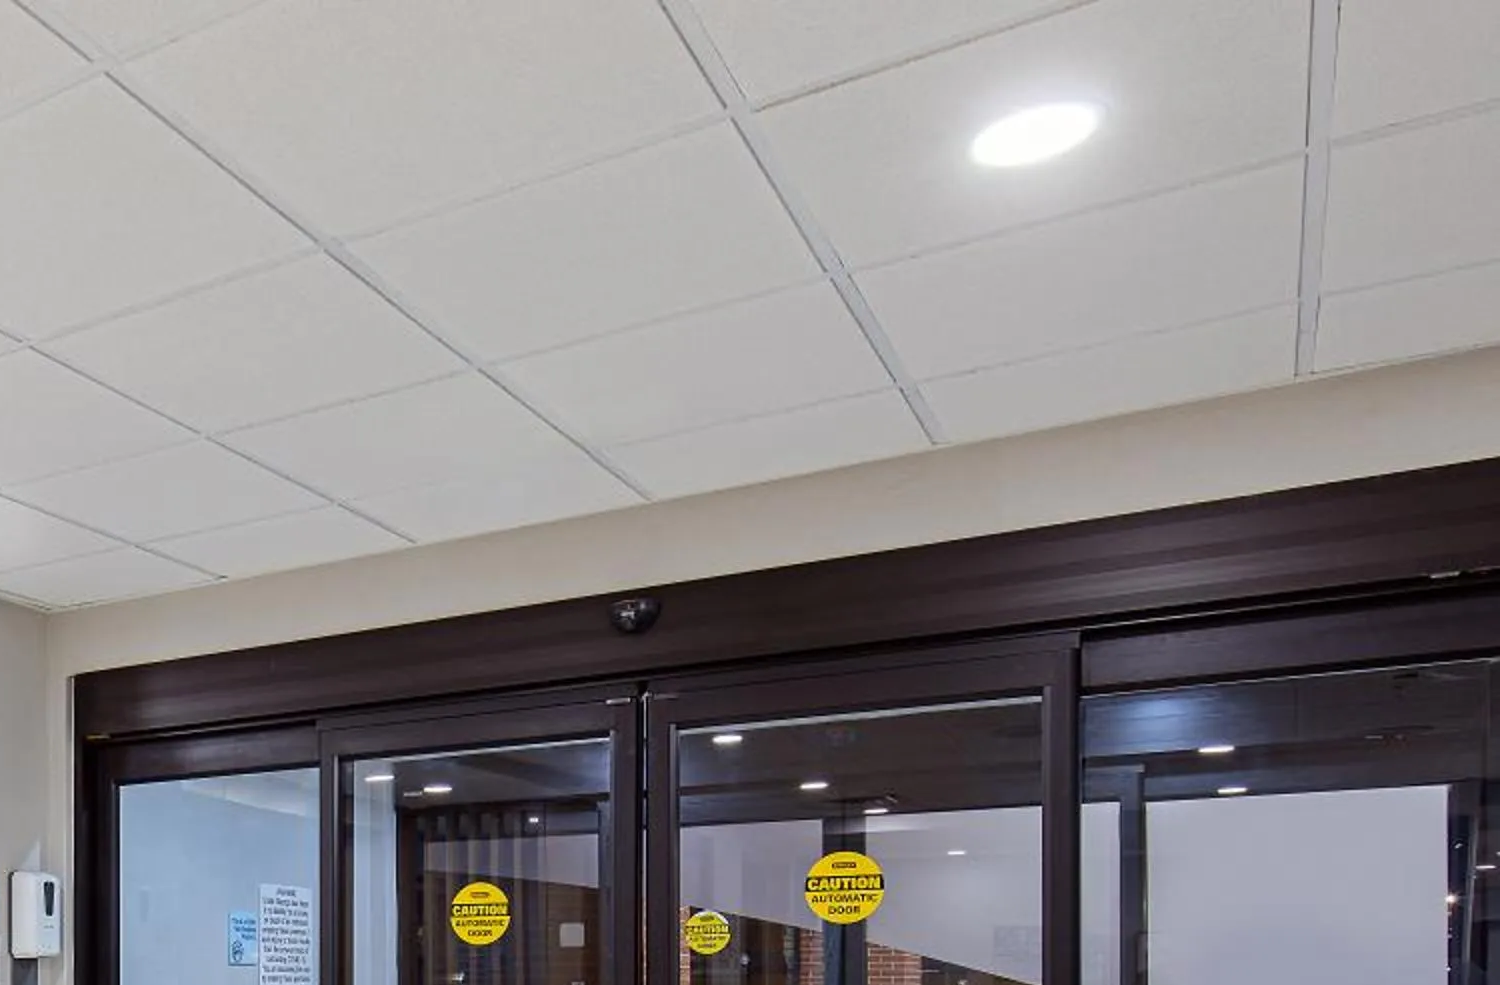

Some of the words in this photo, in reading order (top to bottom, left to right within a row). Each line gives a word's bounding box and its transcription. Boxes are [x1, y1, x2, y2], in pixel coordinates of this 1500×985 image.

[807, 877, 880, 891] CAUTION
[811, 894, 878, 903] AUTOMATIC
[453, 905, 508, 917] CAUTION
[828, 905, 861, 915] DOOR
